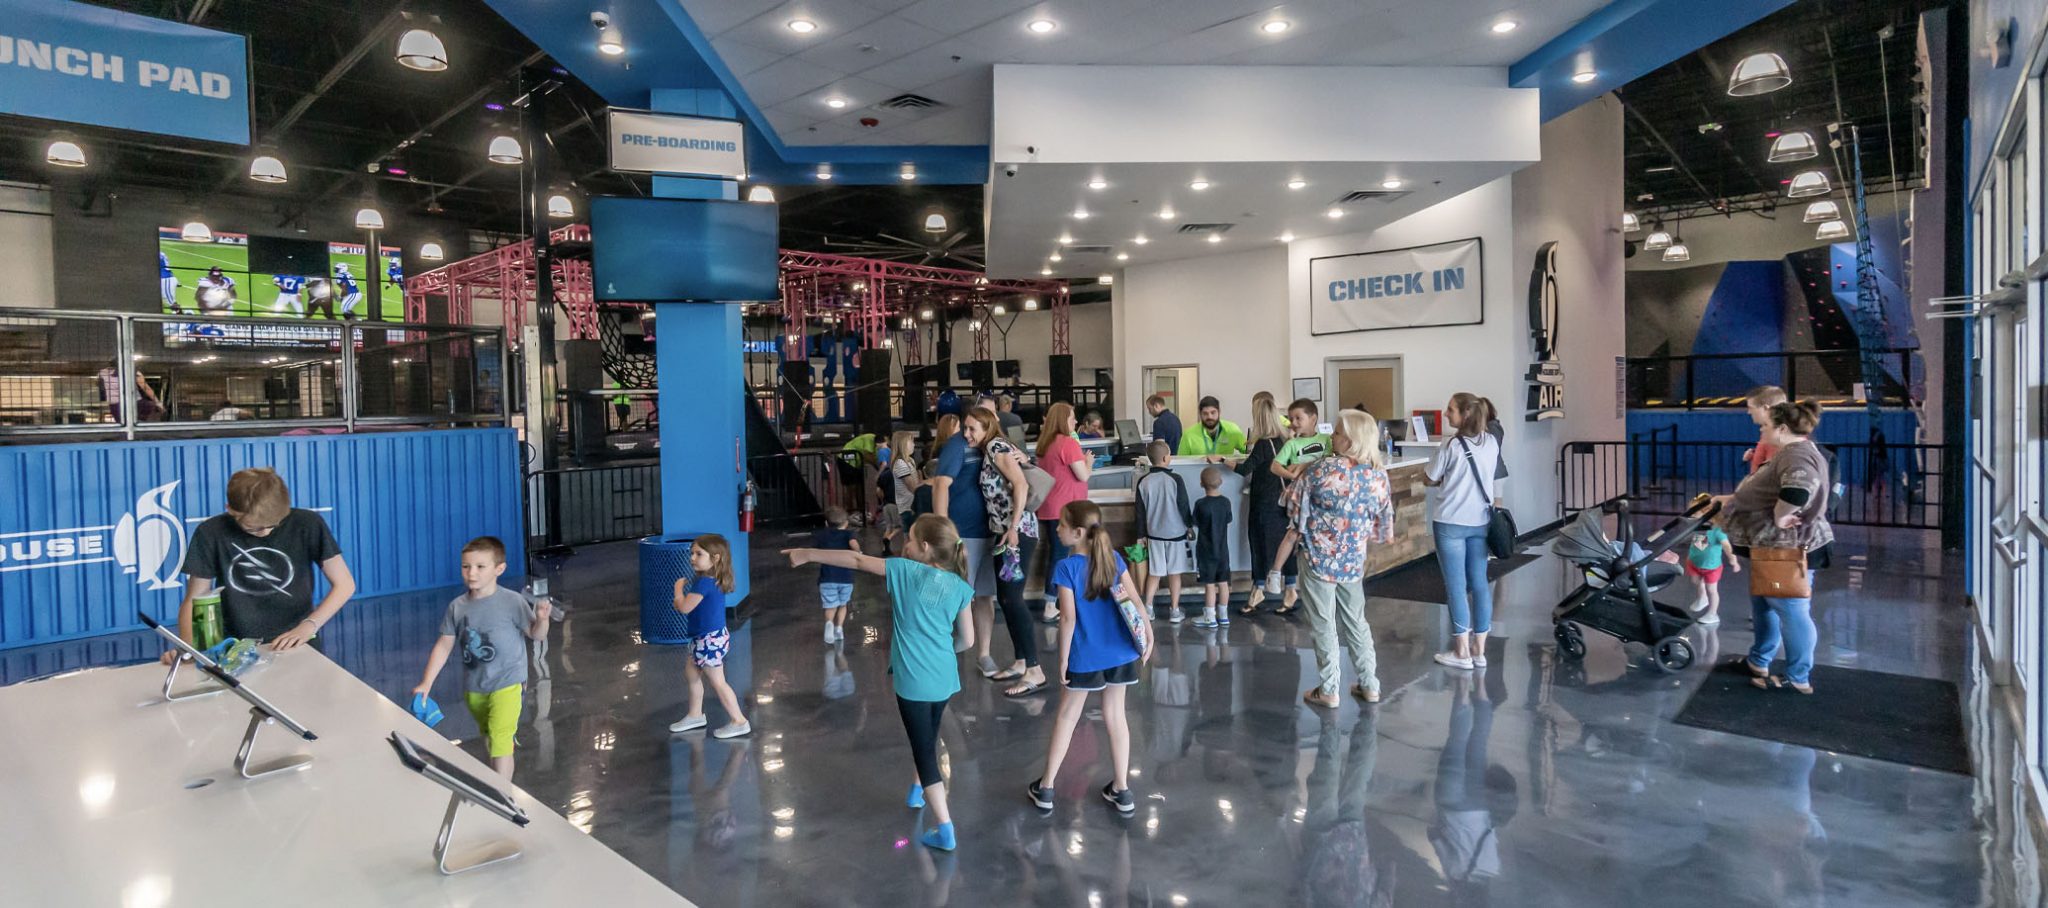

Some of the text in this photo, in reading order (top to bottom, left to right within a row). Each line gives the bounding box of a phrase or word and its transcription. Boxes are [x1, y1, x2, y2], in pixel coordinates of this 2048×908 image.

[138, 60, 231, 99] PAD
[621, 133, 737, 153] PRE-BOARDING
[1328, 266, 1465, 302] CHECK IN
[1539, 384, 1564, 409] AIR
[0, 535, 103, 562] USE
